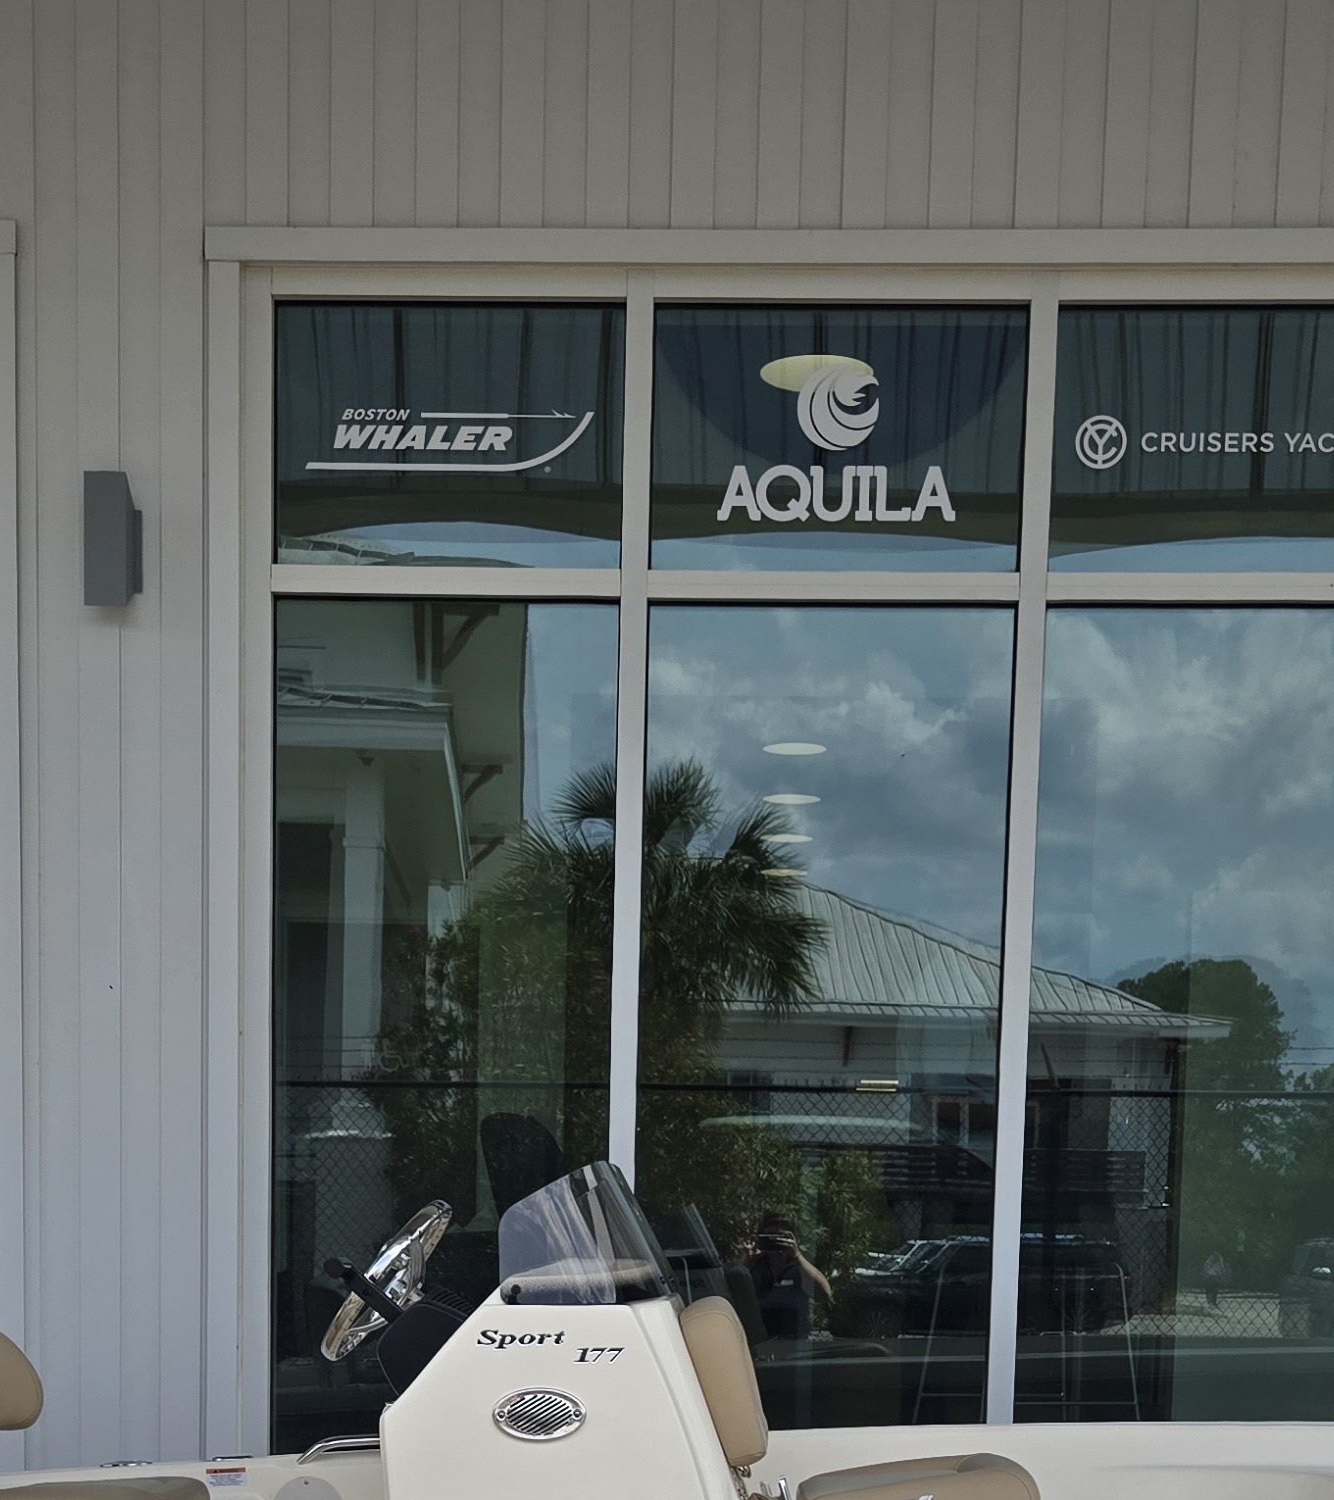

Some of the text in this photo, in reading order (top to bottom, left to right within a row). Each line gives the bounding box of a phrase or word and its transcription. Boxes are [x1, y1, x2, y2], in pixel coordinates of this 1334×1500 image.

[342, 409, 410, 421] BOSTON
[333, 425, 513, 451] WHALER
[1141, 432, 1274, 452] CRUISERS
[717, 464, 956, 522] AQUILA
[477, 1329, 565, 1349] Sport
[574, 1347, 624, 1363] 177
